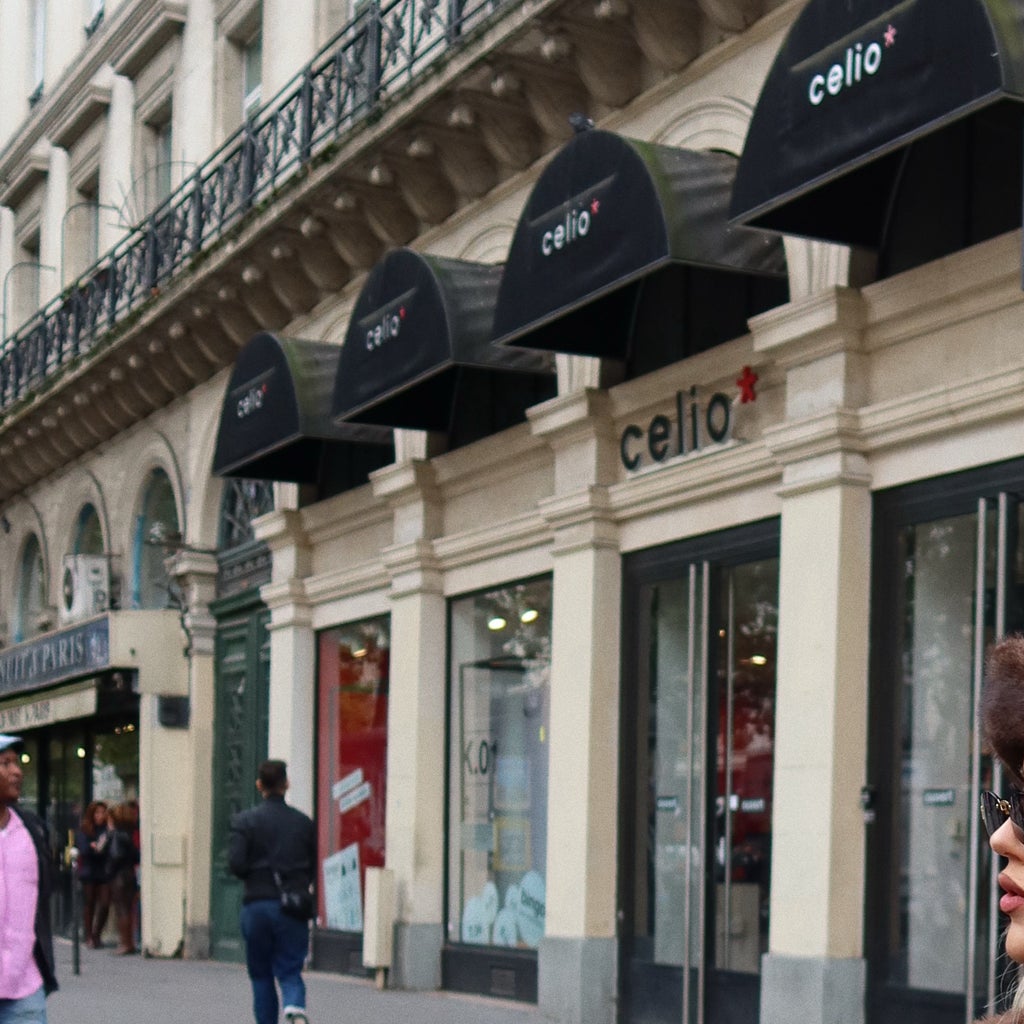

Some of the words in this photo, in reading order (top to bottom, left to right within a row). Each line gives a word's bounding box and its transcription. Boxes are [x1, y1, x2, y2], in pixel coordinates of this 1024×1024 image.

[809, 42, 882, 106] celio
[542, 209, 590, 256] celio
[621, 384, 730, 470] celio
